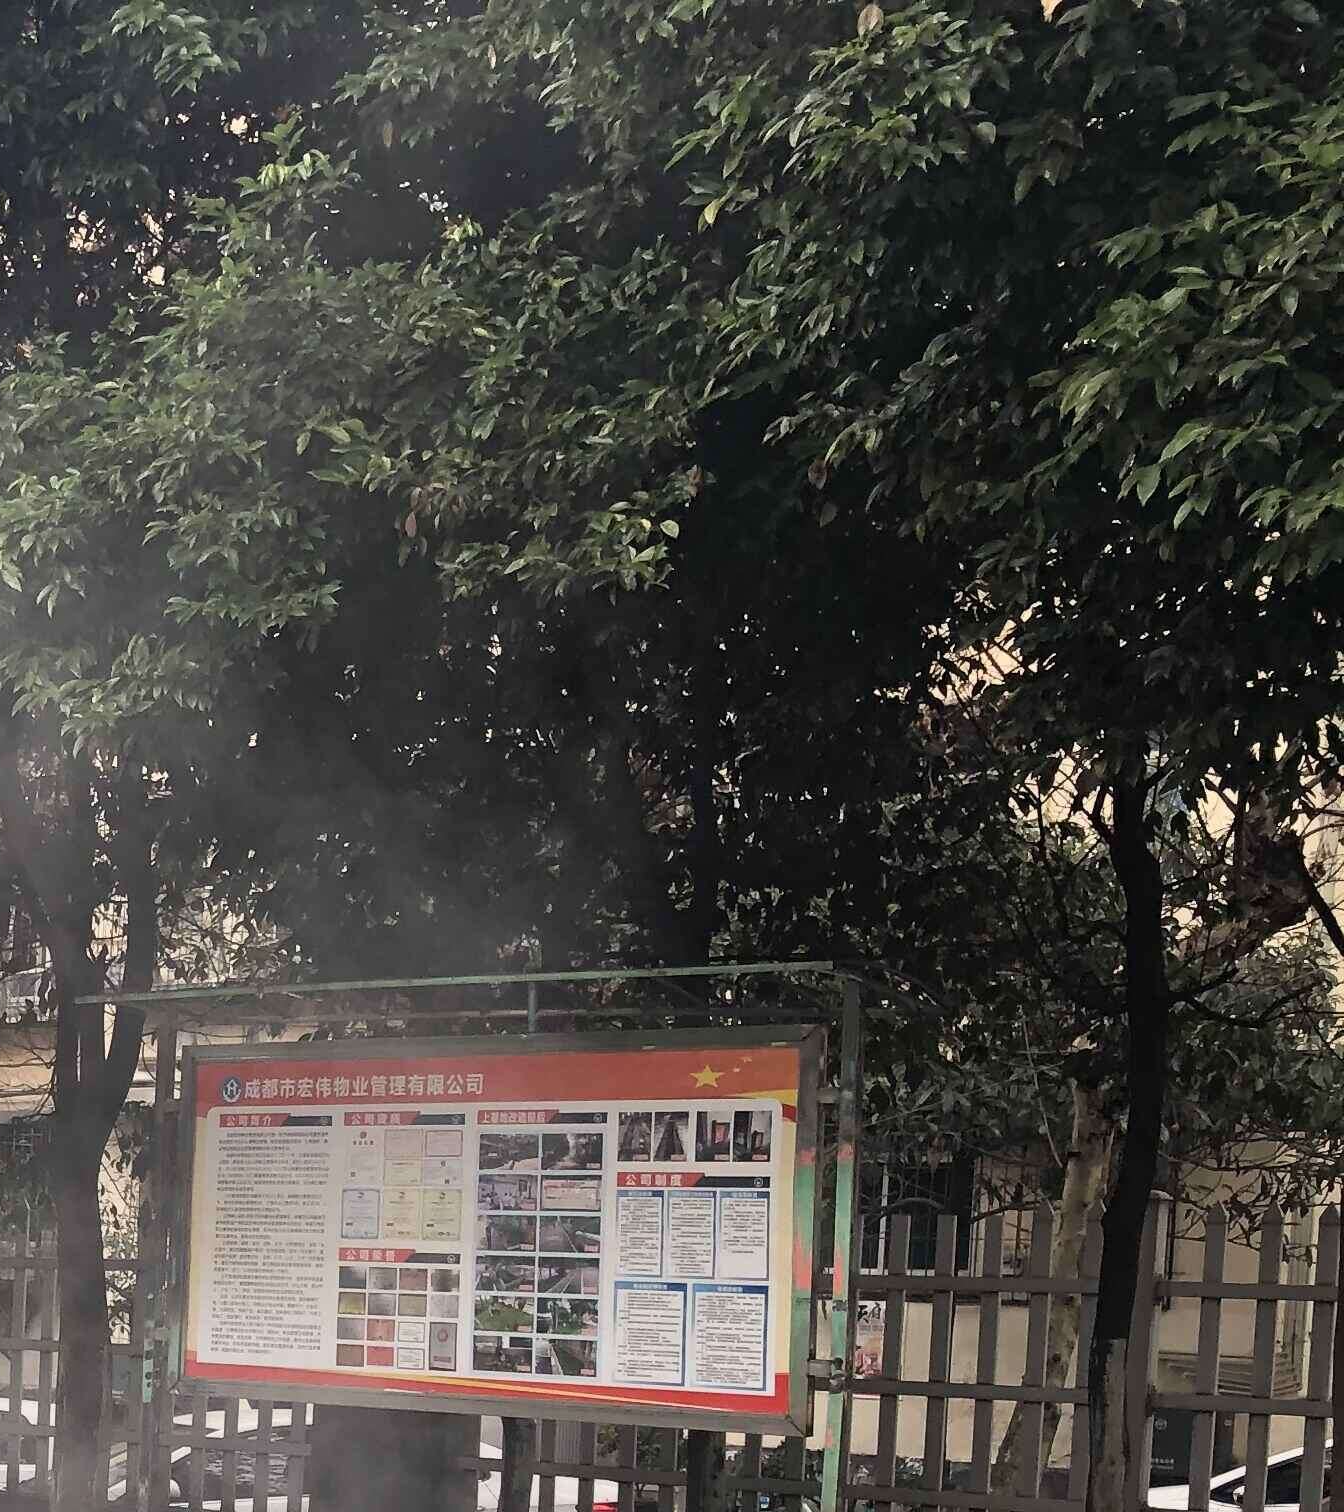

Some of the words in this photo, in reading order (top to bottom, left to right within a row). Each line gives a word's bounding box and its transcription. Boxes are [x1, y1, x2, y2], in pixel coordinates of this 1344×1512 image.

[243, 1073, 485, 1100] 成都市宏伟物业管理有限公司
